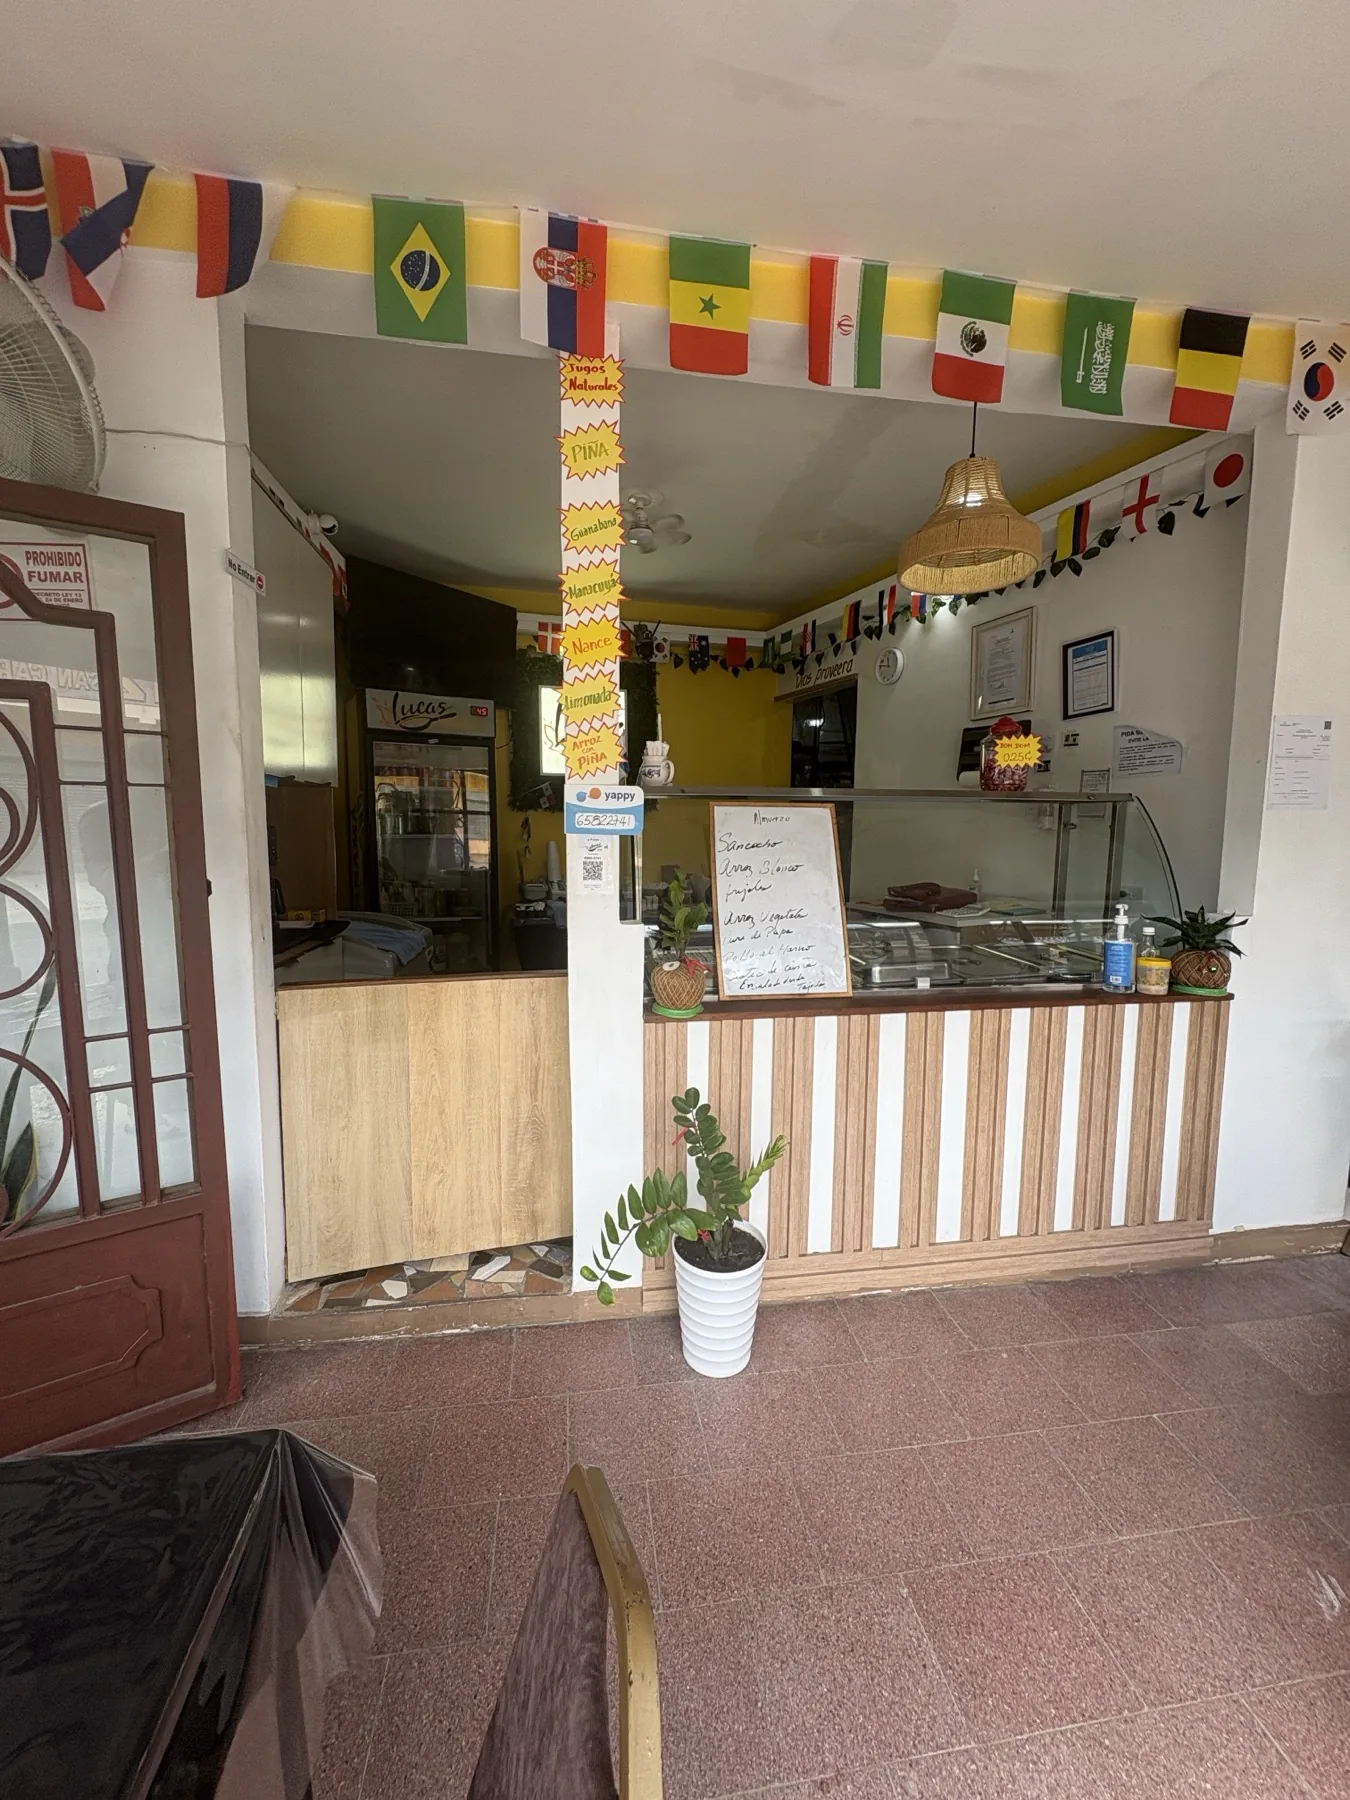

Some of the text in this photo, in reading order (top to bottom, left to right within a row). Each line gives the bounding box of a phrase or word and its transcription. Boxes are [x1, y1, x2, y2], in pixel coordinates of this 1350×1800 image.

[567, 363, 606, 375] Jugos
[569, 376, 619, 392] Naturales
[571, 440, 610, 463] PIÑA
[25, 550, 82, 567] PROHIBIDO
[27, 570, 84, 583] FUMAR
[228, 557, 256, 583] No Entrar
[572, 637, 613, 655] Nance
[393, 691, 452, 725] Lucas
[605, 792, 635, 802] yappy
[576, 814, 631, 827] 65822741
